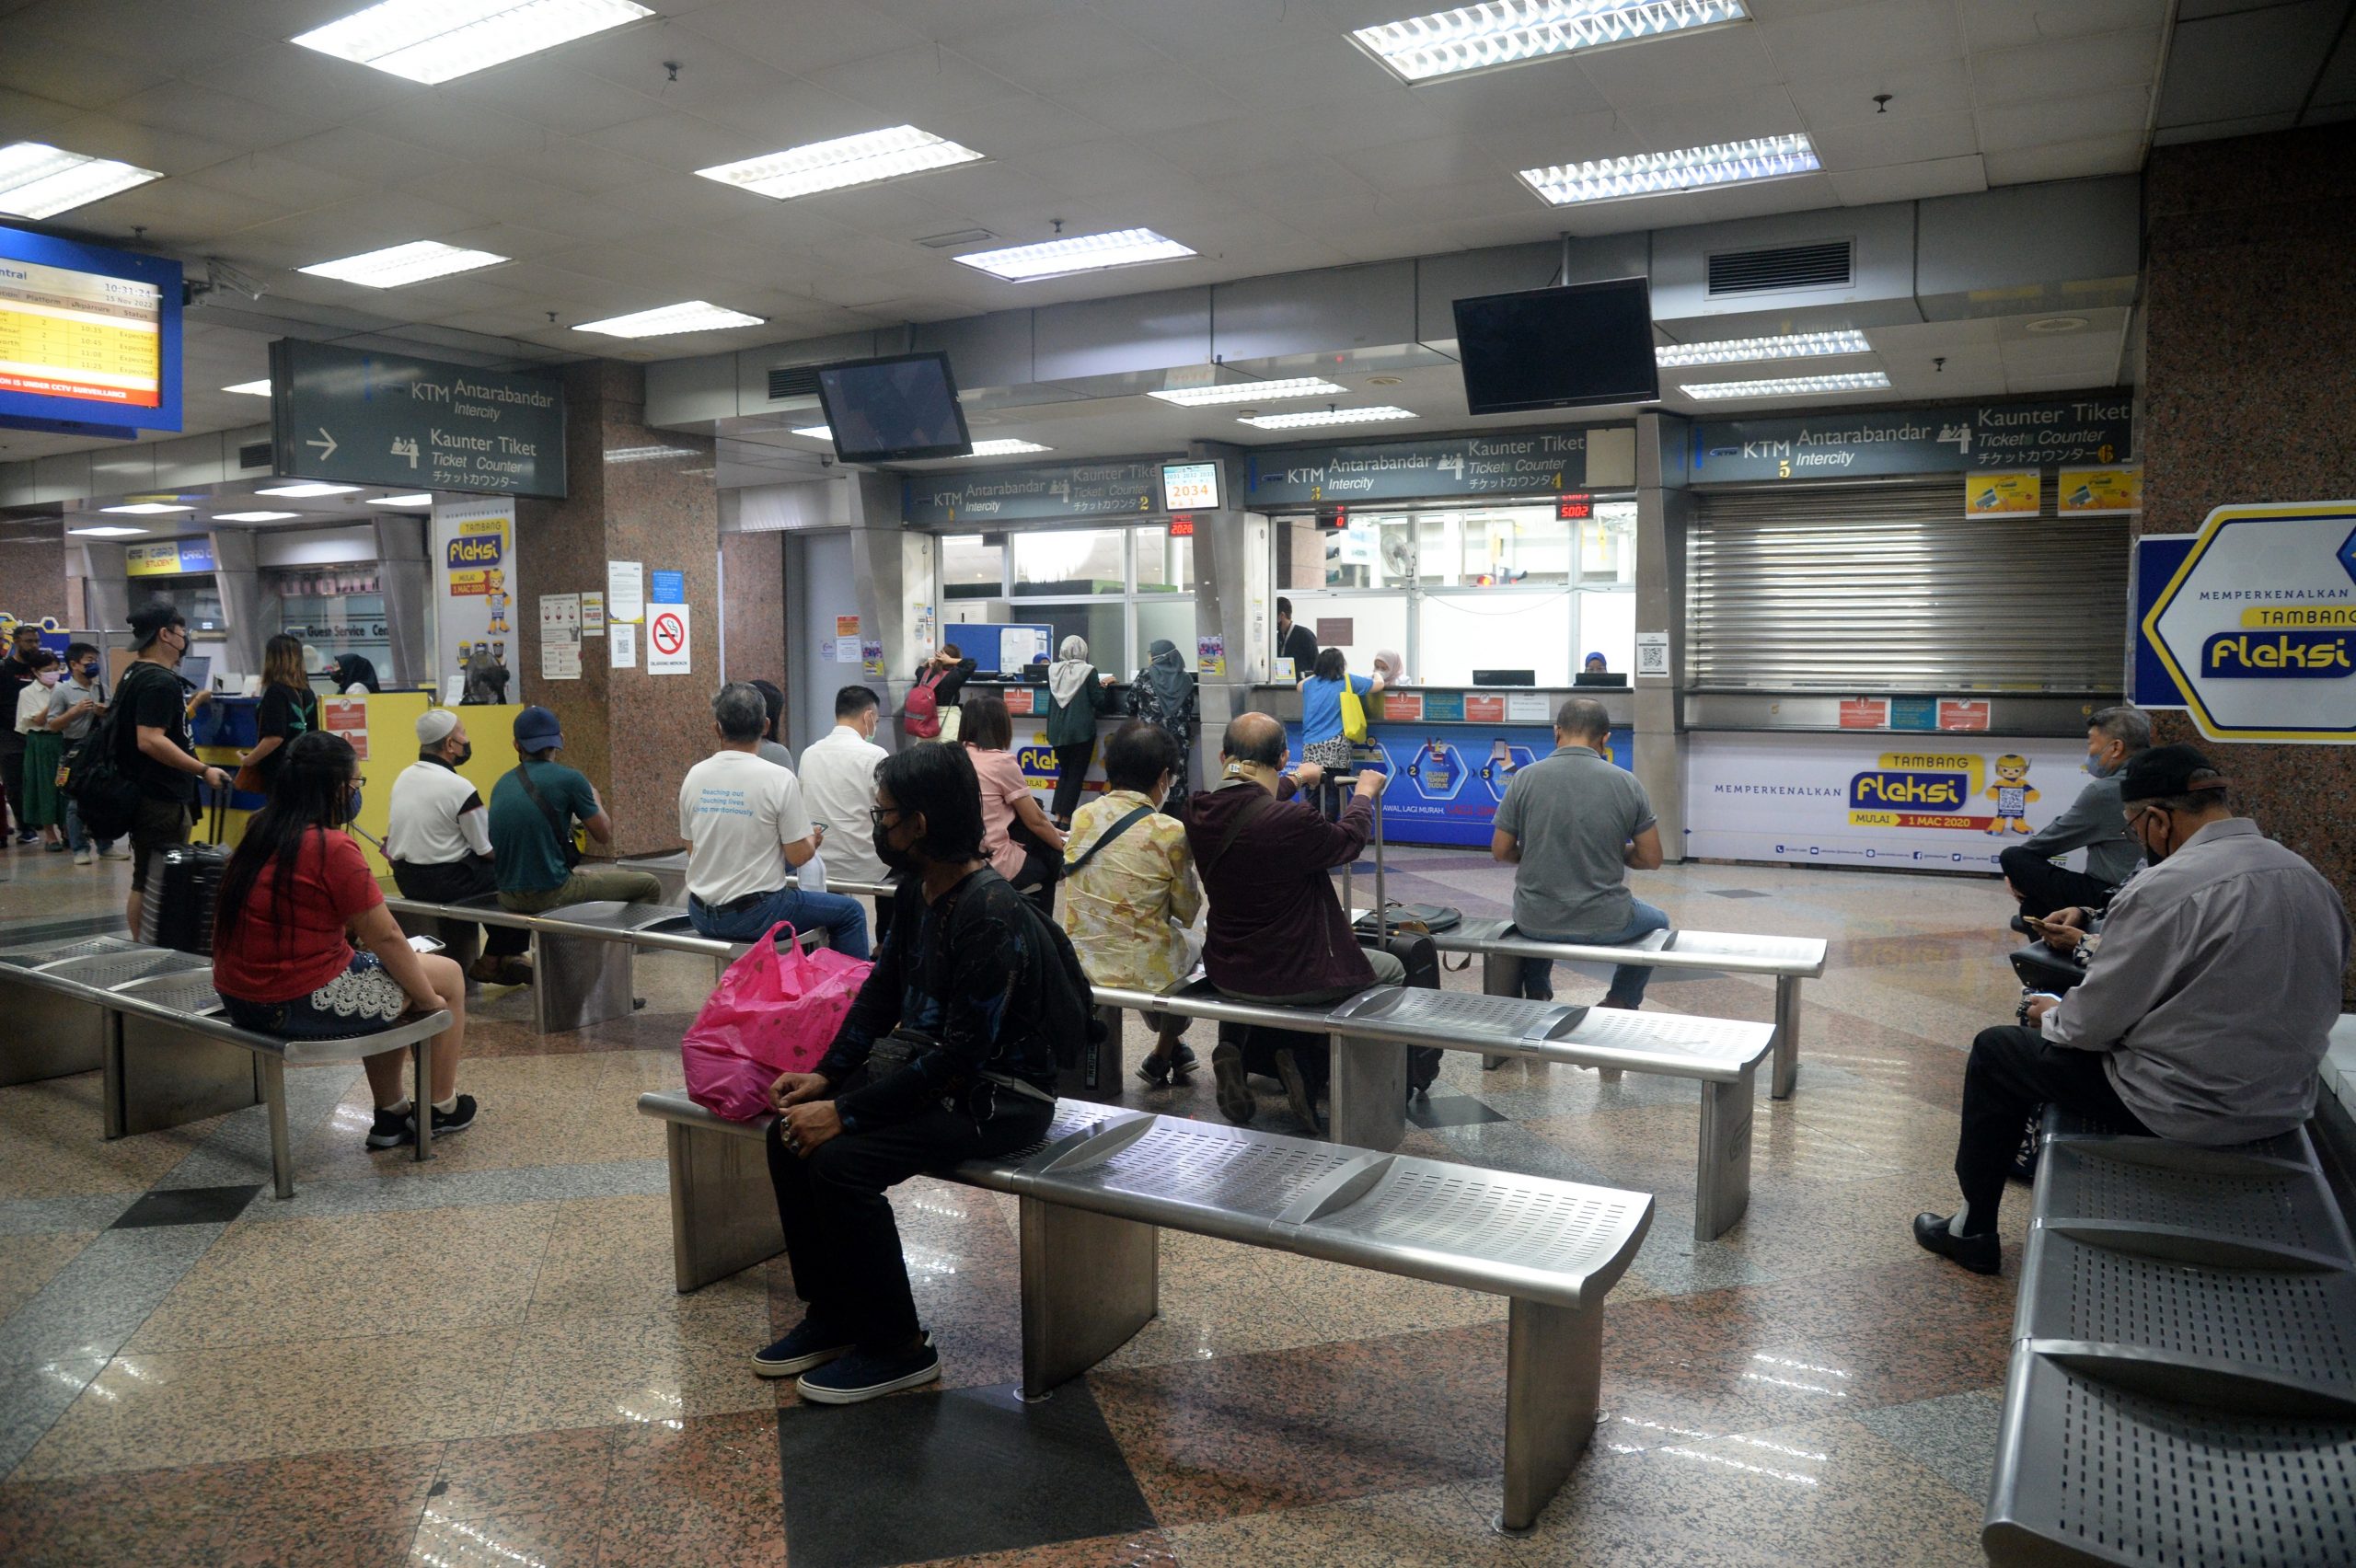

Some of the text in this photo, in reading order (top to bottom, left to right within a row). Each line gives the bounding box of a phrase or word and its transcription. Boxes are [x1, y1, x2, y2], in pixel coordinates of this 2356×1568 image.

[105, 283, 151, 297] 10:31:24
[27, 294, 61, 305] Platform
[123, 310, 148, 319] Status
[134, 300, 153, 308] 2022
[120, 331, 154, 341] Expected
[120, 344, 154, 353] Expected
[120, 355, 154, 364] Expected
[120, 367, 154, 375] Expected
[23, 380, 50, 389] UNDER
[52, 384, 72, 392] CCTV
[73, 386, 127, 398] SURVEILLANCE
[411, 378, 554, 408] KTM Antarabandar
[455, 402, 502, 422] Intercity
[1744, 441, 1790, 458] KTM
[1796, 423, 1932, 446] Antarabandar
[1979, 409, 2064, 427] Kaunter
[2072, 403, 2130, 421] Tiket
[431, 428, 537, 456] Kaunter Tiket
[1796, 430, 2105, 467] Intercity Ticket Counter
[1288, 467, 1323, 484] KTM
[1328, 454, 1433, 473] Antarabandar
[1468, 441, 1534, 456] Kaunter
[1540, 435, 1585, 452] Tiket
[1978, 448, 2097, 466] チケットカウンター
[2097, 444, 2114, 464] 6
[432, 452, 523, 473] Ticket Counter
[1779, 460, 1791, 478] 5
[433, 471, 518, 488] チケットカウンター
[1328, 459, 1567, 490] Intercity Ticket Counter
[934, 464, 1156, 506] KTM Antarabandar Kaunter Tike
[1173, 484, 1208, 497] 2034
[965, 485, 1149, 513] Intercity Ticket Counter
[1311, 486, 1322, 501] 3
[1139, 496, 1149, 511] 2
[466, 522, 501, 532] TAMBANG
[1335, 516, 1345, 528] 0
[146, 559, 173, 568] STUDENT
[2200, 589, 2349, 601] MEMPERKENALKAN
[307, 626, 332, 637] Guest
[334, 625, 365, 637] Service
[1021, 749, 1060, 770] flek
[1893, 755, 1969, 768] TAMBANG
[1410, 766, 1416, 775] 2
[1483, 769, 1489, 778] 3
[1715, 784, 1841, 797] MEMPERKENALKAN
[1855, 814, 1890, 824] MULAI
[1909, 817, 1971, 827] 1 MAC 2020
